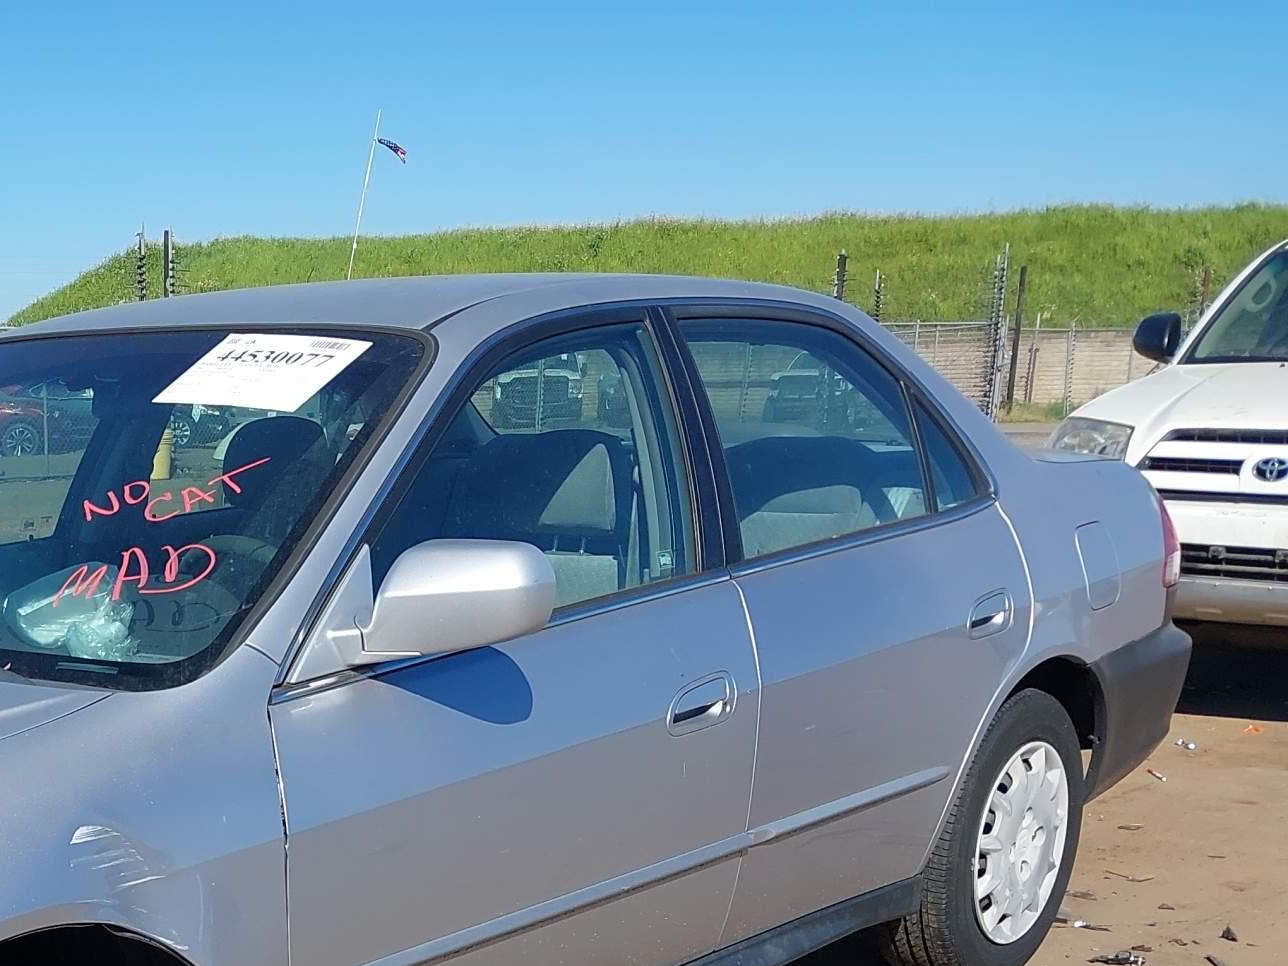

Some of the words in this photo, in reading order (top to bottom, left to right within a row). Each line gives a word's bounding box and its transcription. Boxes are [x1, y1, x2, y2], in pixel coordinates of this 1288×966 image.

[216, 348, 336, 368] 44530077
[82, 480, 151, 522] NO
[144, 456, 272, 523] CAT
[52, 543, 217, 609] MAD
